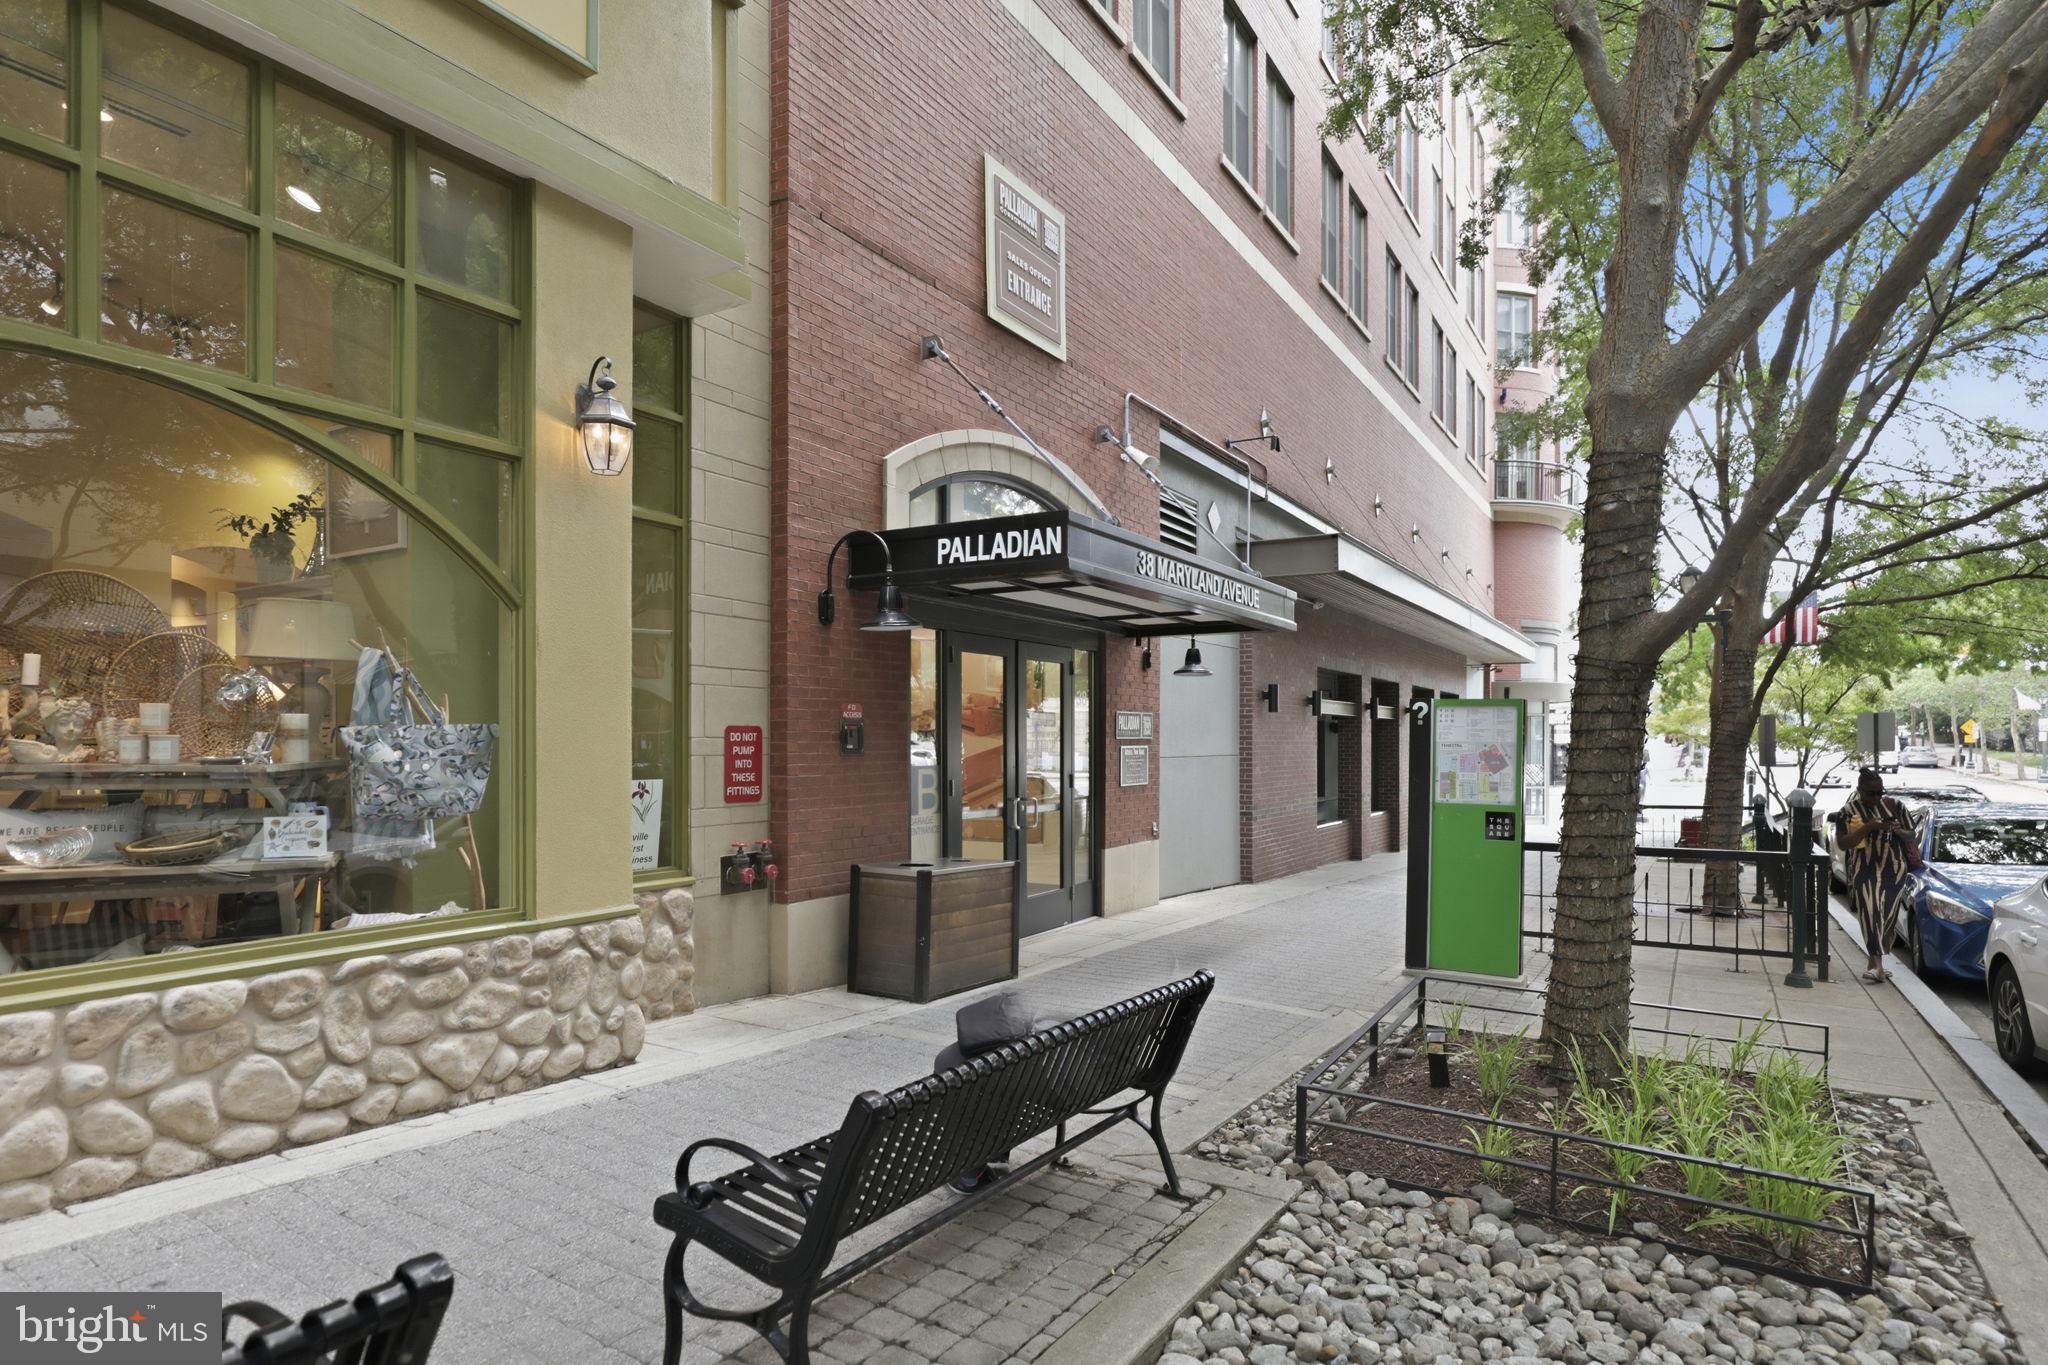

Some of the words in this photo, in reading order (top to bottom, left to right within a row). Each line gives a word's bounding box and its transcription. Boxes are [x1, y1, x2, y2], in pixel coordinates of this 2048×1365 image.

[1000, 182, 1037, 232] PALLADIAN
[1007, 250, 1028, 271] SALES
[1029, 266, 1052, 288] OFFICE
[1007, 269, 1052, 317] ENTRANCE
[937, 526, 1062, 565] PALLADIAN
[1138, 551, 1154, 577] 38
[1157, 557, 1221, 596] MARYLAND
[1222, 579, 1260, 609] AVENUE
[730, 732, 741, 742] DO
[742, 732, 757, 742] NOT
[732, 745, 755, 755] PUMP
[735, 759, 752, 769] INTO
[731, 772, 756, 782] THESE
[726, 785, 760, 796] FITTINGS
[918, 768, 939, 815] B
[19, 827, 39, 836] ARE
